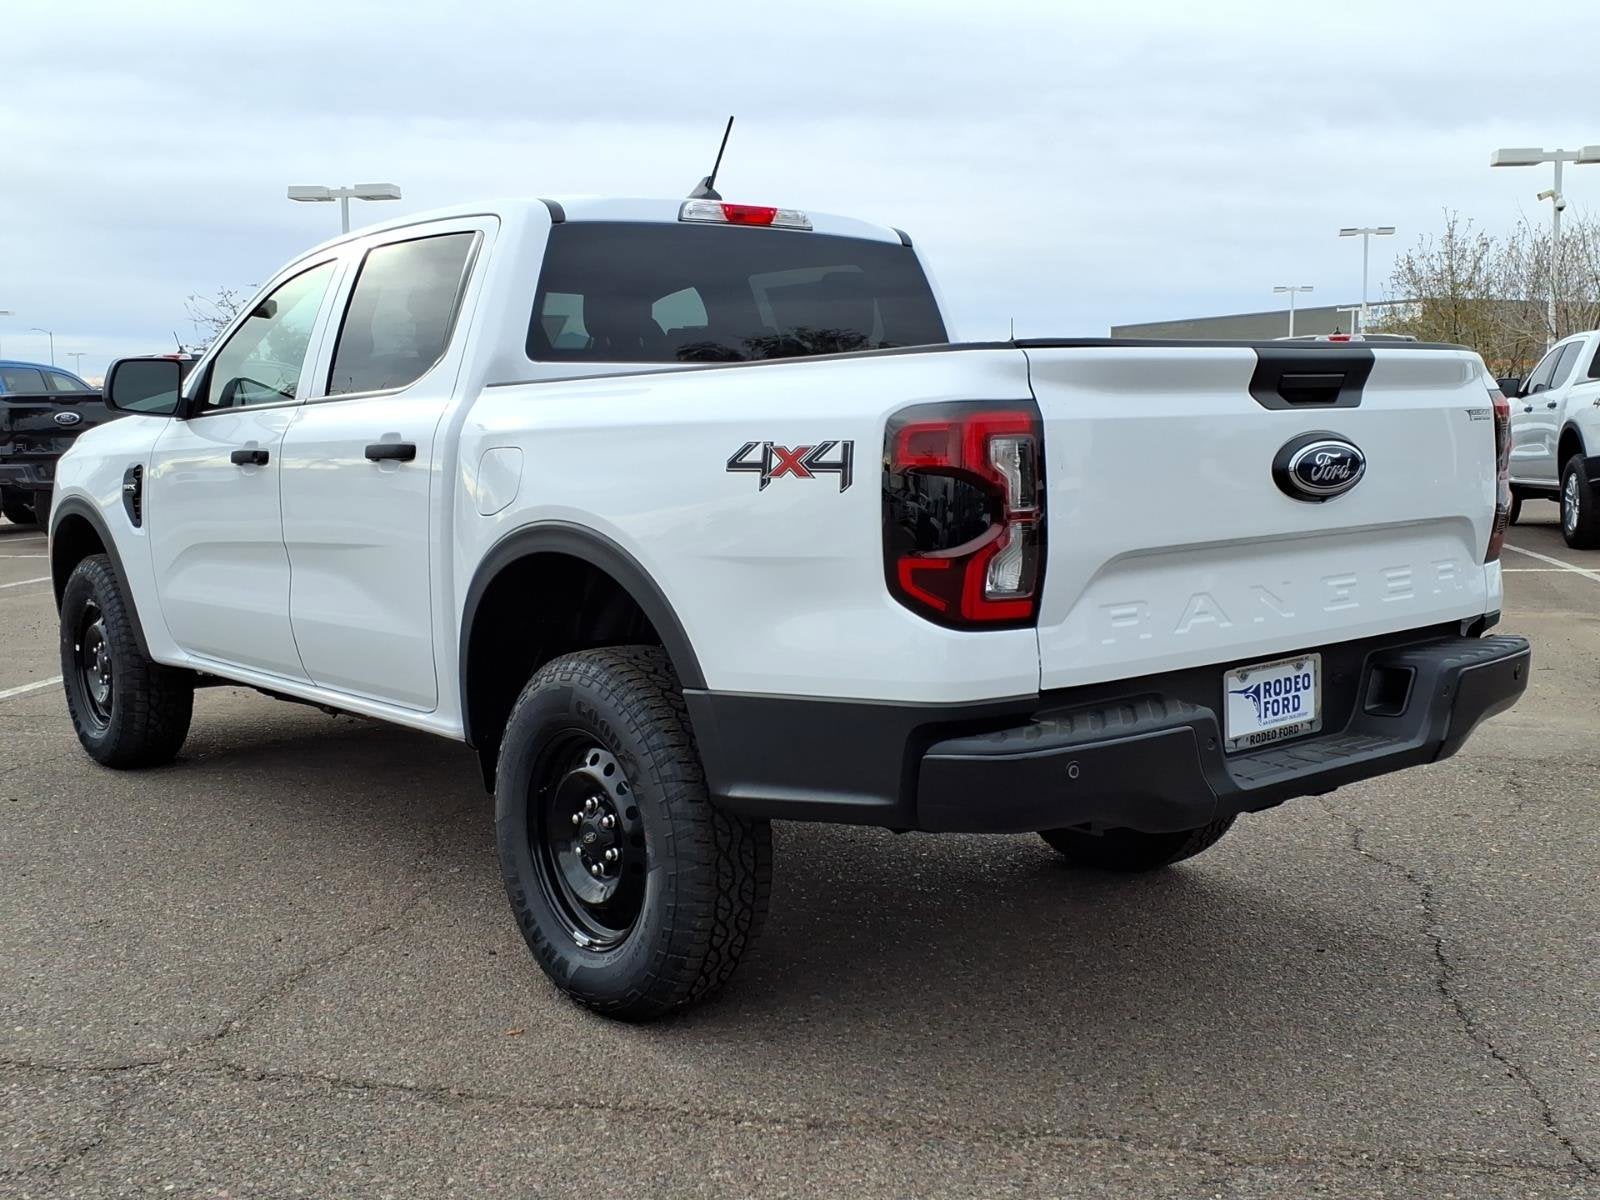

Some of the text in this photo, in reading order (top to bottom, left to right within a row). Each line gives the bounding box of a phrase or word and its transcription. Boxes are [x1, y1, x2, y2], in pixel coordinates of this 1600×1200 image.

[1311, 452, 1351, 481] Ford
[1098, 558, 1467, 646] RANGER
[1263, 674, 1311, 699] RODEO
[1263, 695, 1300, 718] FORD
[1250, 731, 1276, 745] RODEO
[1278, 725, 1299, 739] FORD
